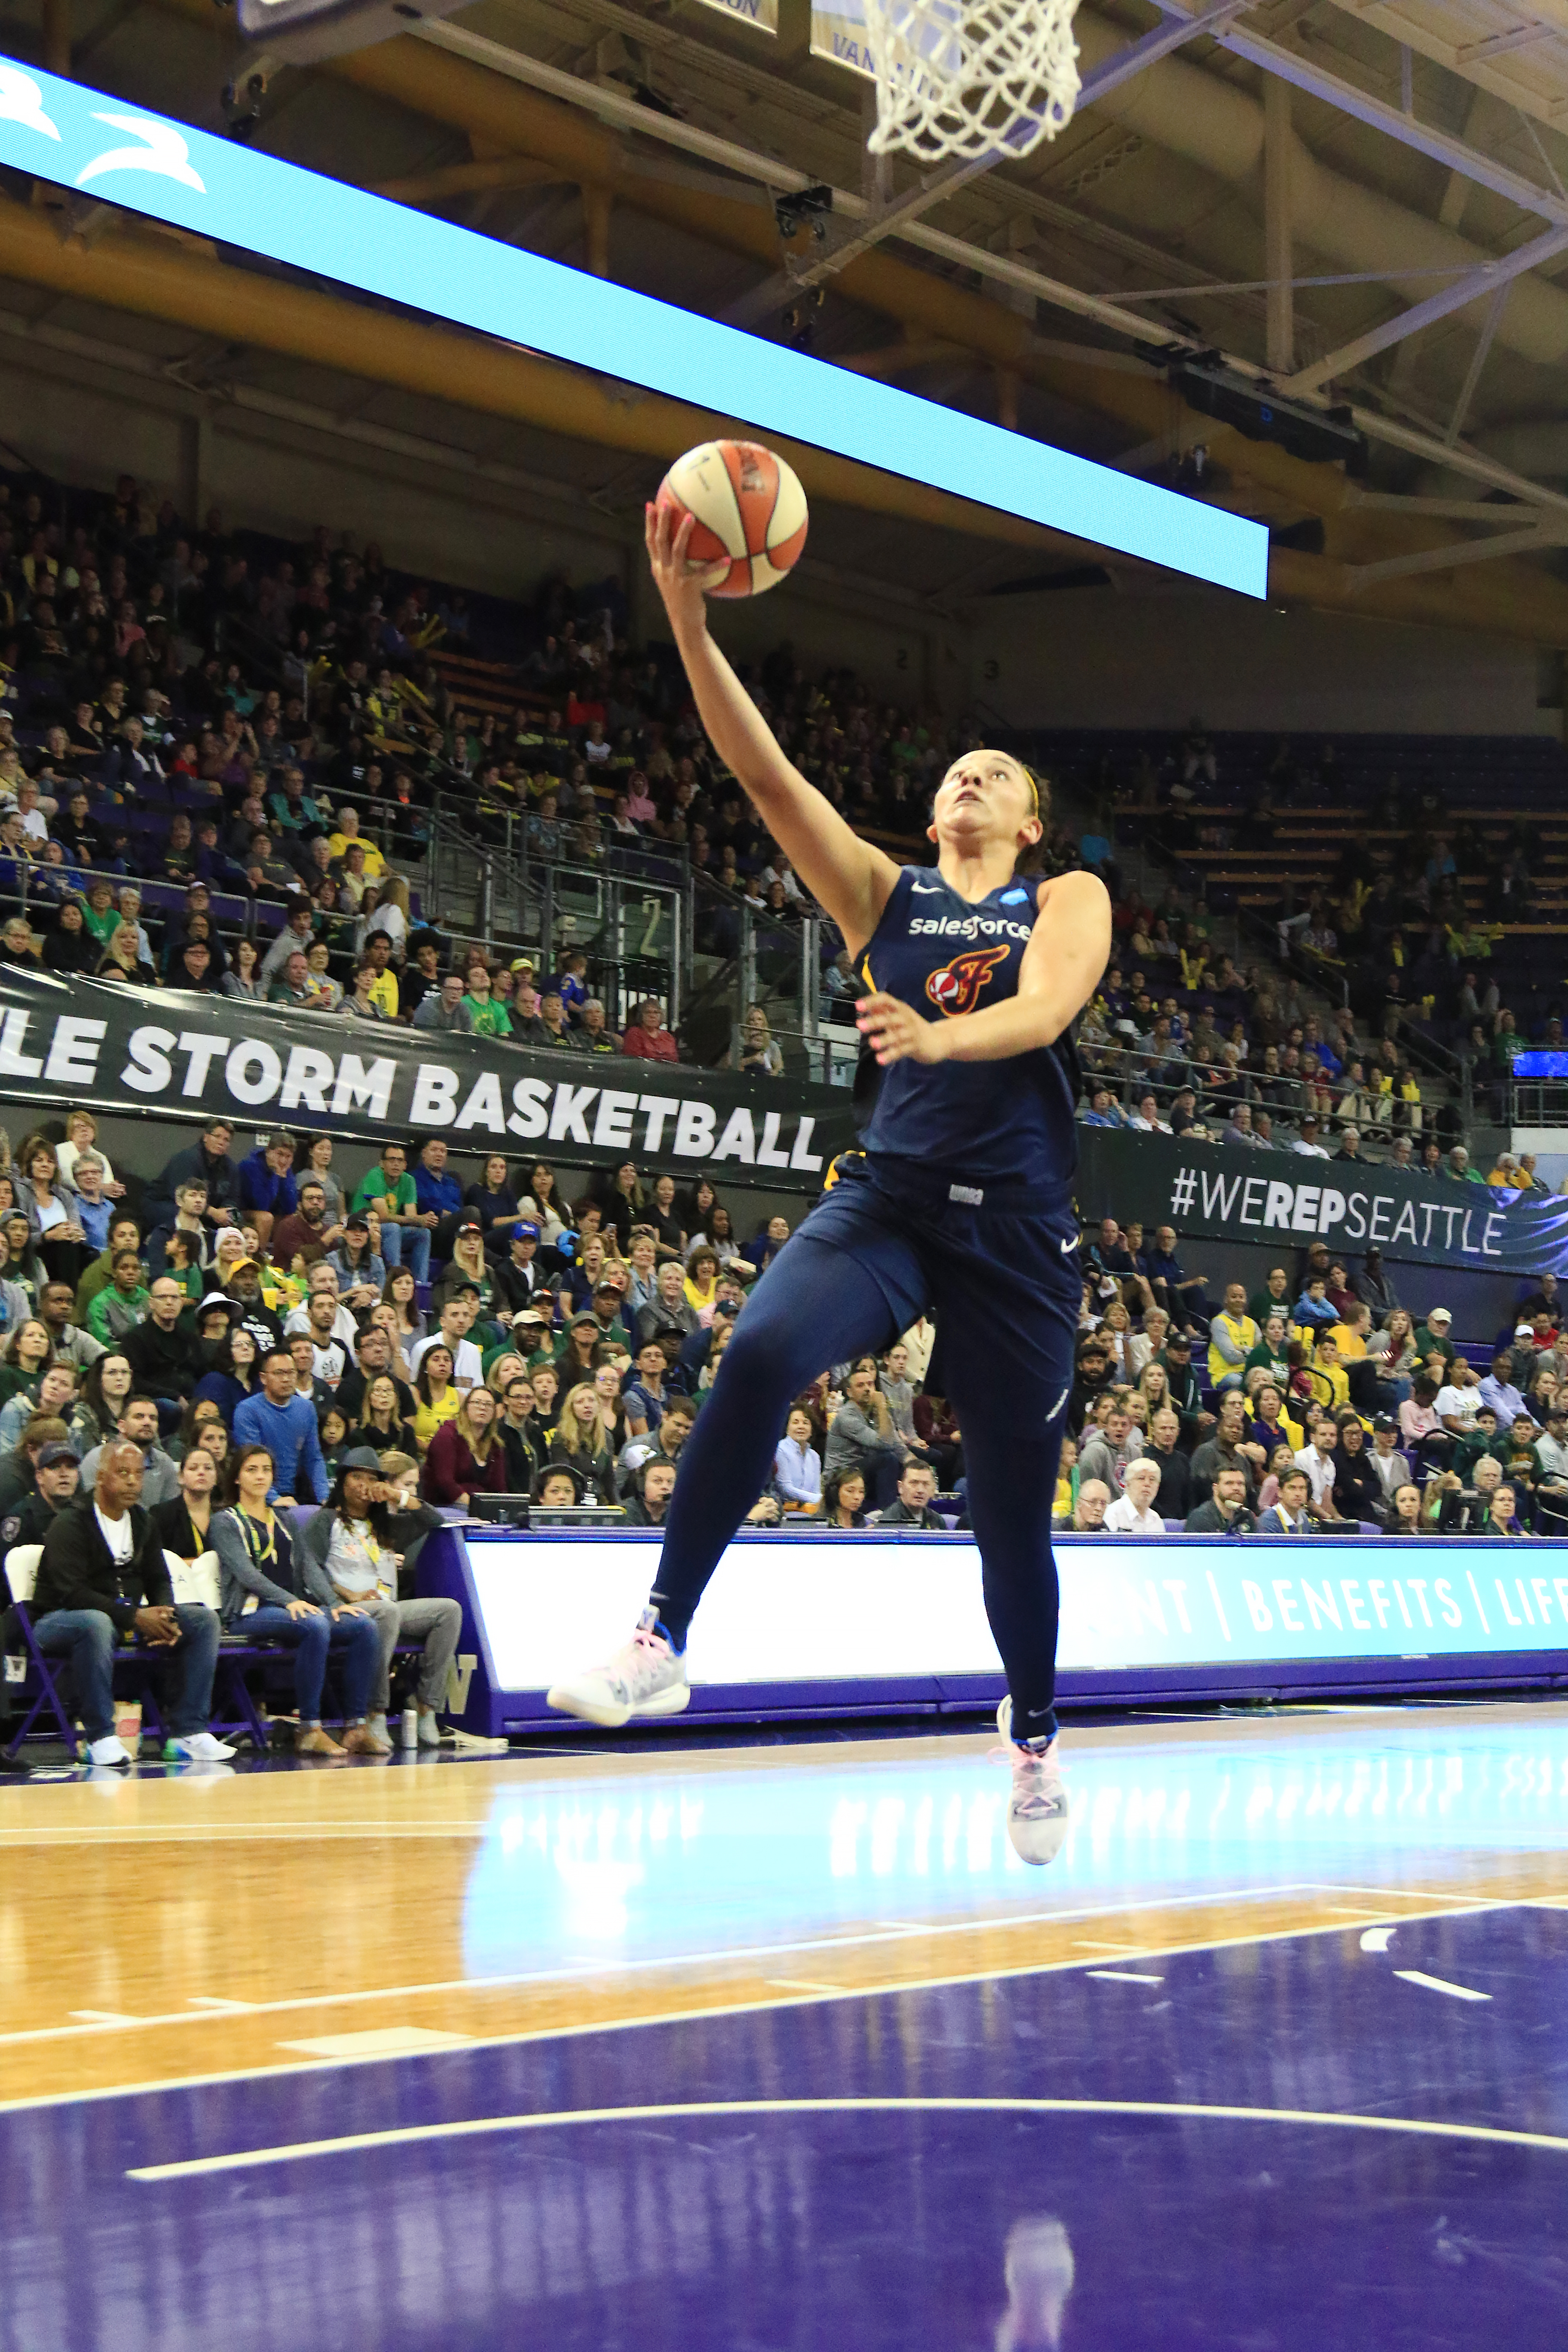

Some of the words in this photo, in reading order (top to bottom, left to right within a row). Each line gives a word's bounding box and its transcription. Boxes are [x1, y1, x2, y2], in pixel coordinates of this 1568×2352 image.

[908, 915, 1031, 941] salesforce
[0, 1006, 107, 1084] LE
[120, 1025, 397, 1119] STORM
[409, 1063, 824, 1172] BASKETBALL
[1170, 1167, 1507, 1256] #WEREPSEATTLE
[1241, 1578, 1462, 1632] BENEFITS
